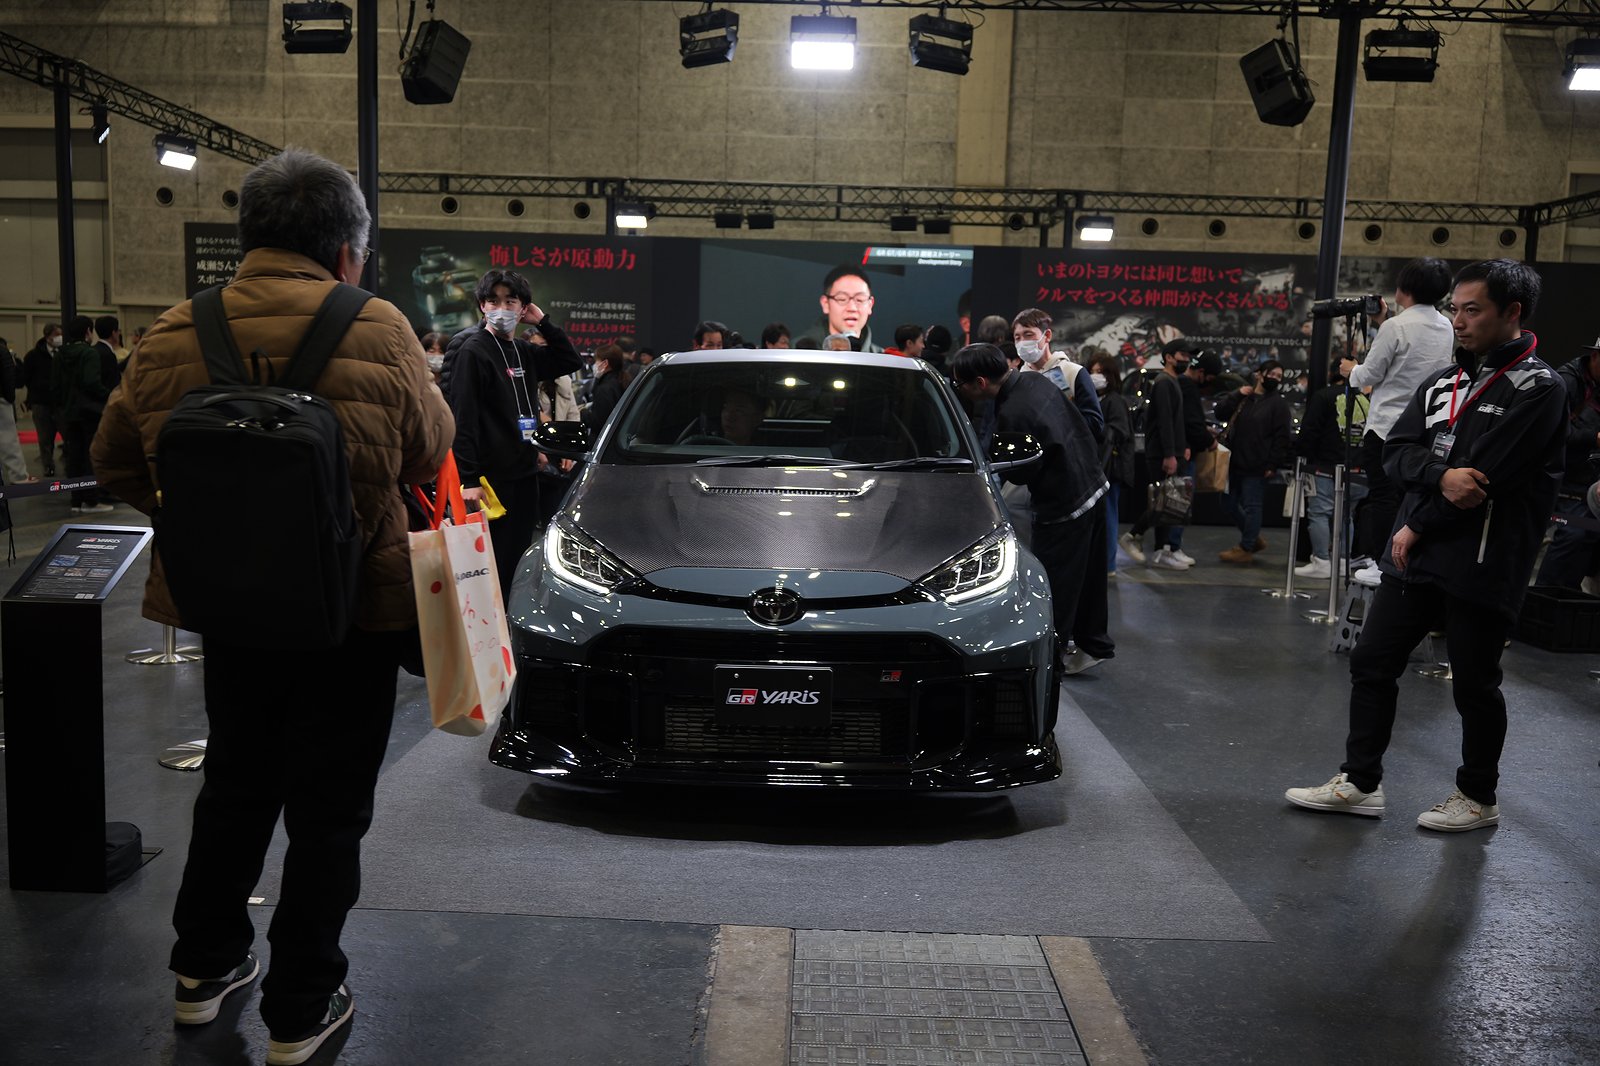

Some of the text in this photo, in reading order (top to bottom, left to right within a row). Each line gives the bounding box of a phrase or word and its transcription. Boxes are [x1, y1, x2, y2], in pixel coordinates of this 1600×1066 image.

[489, 244, 637, 270] 悔しさが原動力
[1038, 262, 1243, 285] いまのトヨタには同じ想いで
[1035, 286, 1289, 311] クルマをつくる仲間がたくさんいる
[50, 482, 60, 491] GR
[881, 672, 900, 681] GR
[727, 692, 757, 704] GR
